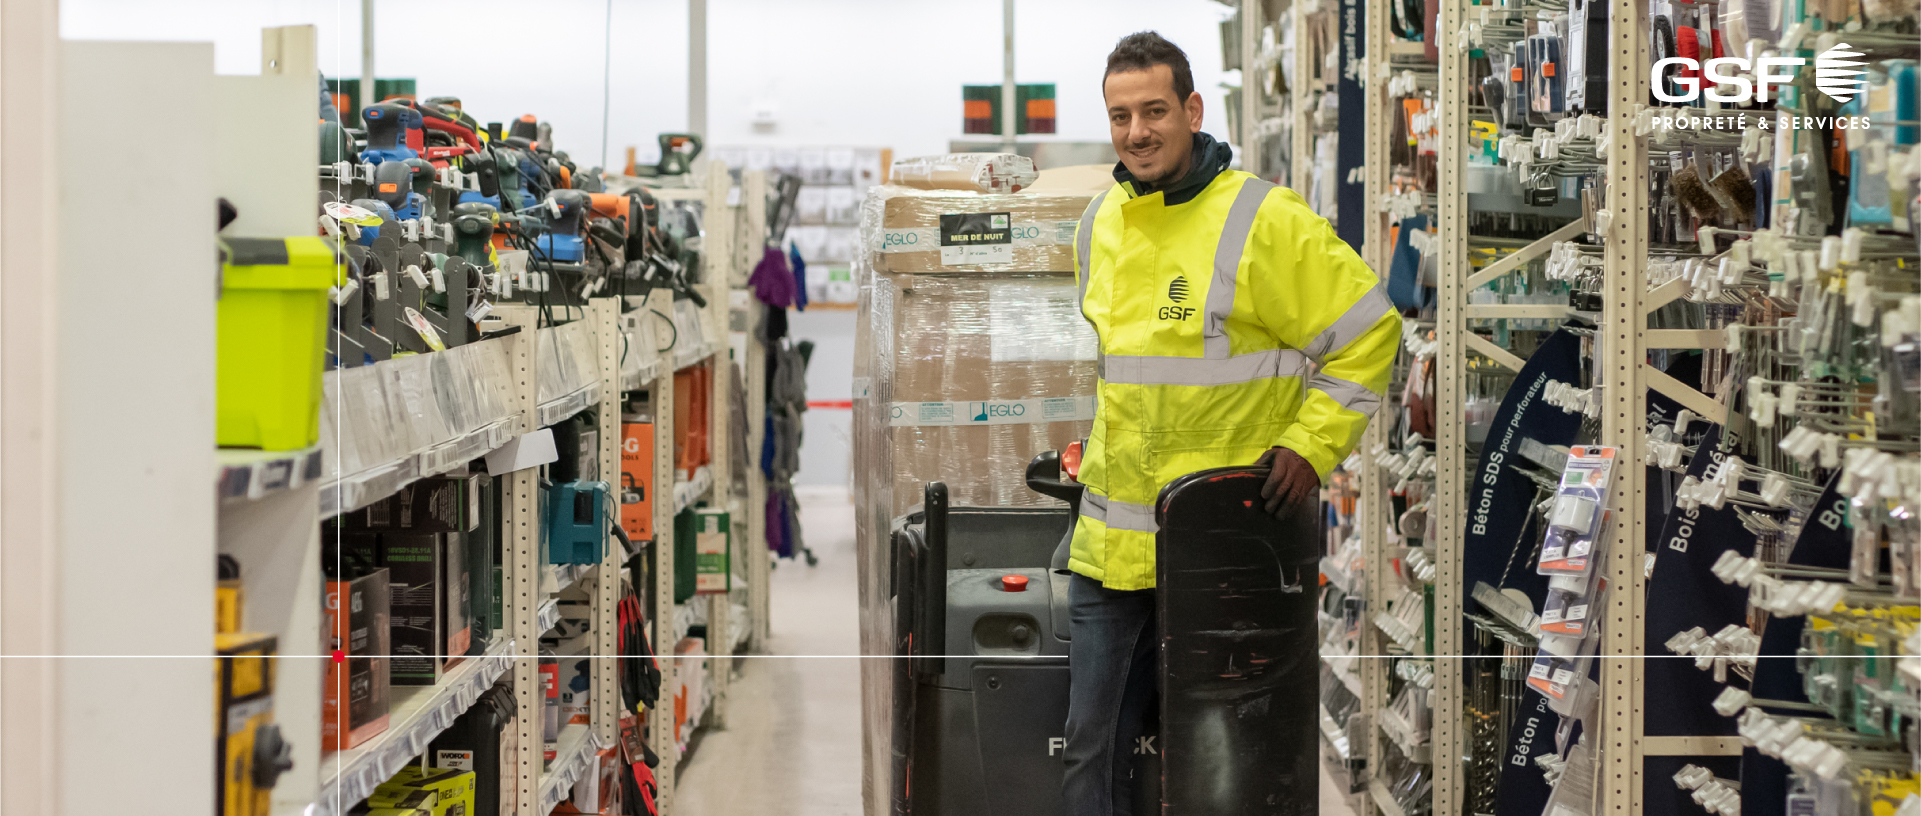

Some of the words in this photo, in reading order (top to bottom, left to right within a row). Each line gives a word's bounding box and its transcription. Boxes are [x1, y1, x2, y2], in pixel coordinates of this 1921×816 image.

[886, 232, 918, 246] EGLO
[951, 234, 969, 242] MER
[970, 233, 982, 241] DE
[984, 233, 1004, 241] NUIT
[1011, 226, 1040, 239] GLO
[1158, 306, 1196, 321] GSF
[990, 404, 1025, 417] EGLO
[1472, 487, 1494, 535] Béton
[1484, 451, 1503, 486] SDS
[1500, 426, 1514, 453] pour
[1511, 371, 1548, 428] perforateur
[1669, 509, 1700, 553] Bois
[1511, 717, 1540, 766] Béton
